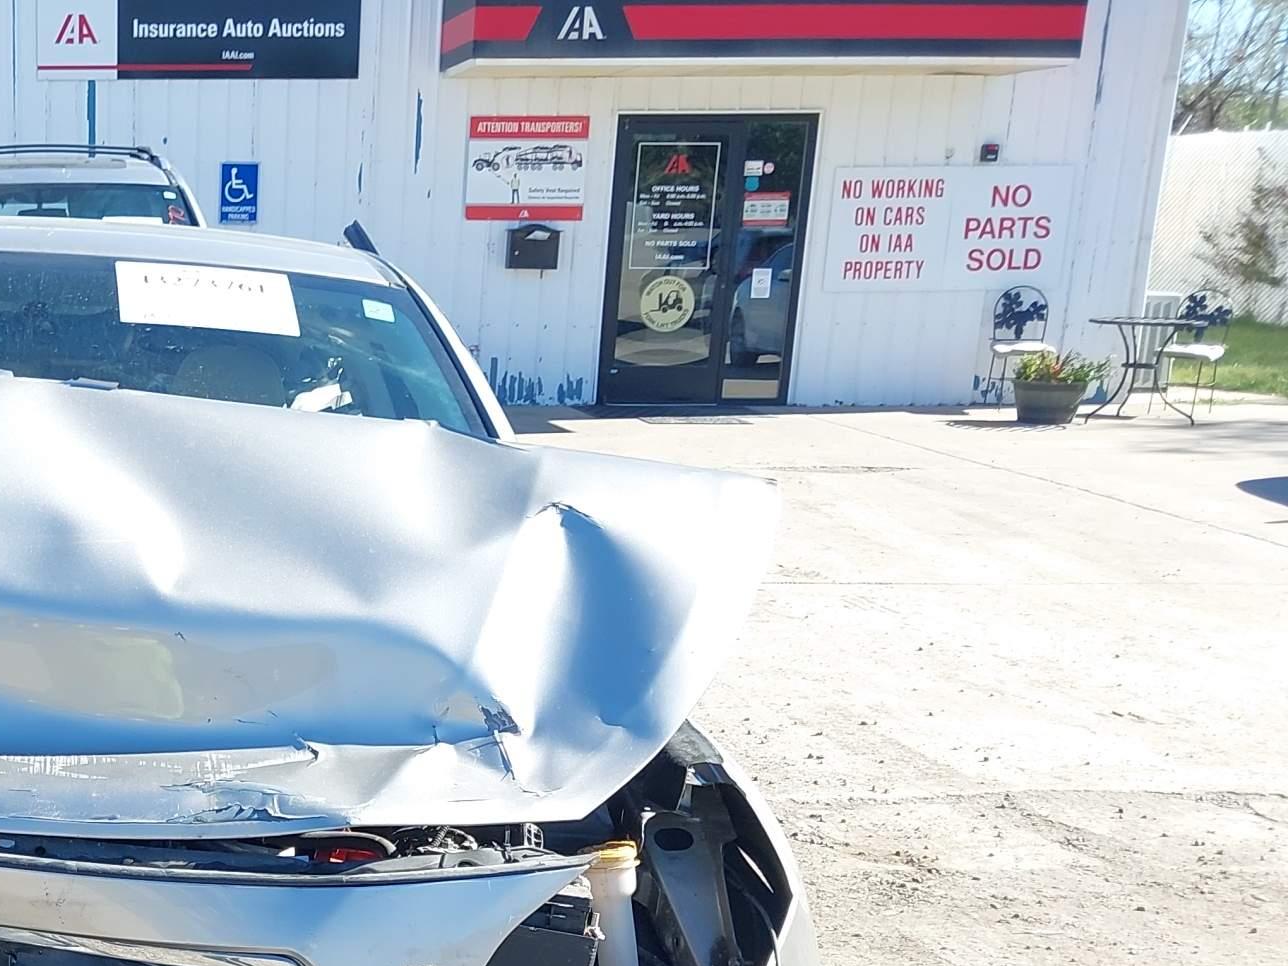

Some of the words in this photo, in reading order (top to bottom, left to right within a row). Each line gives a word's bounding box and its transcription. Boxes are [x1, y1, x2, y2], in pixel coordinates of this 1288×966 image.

[132, 18, 218, 38] Insurance
[223, 18, 263, 38] Auto
[268, 18, 345, 38] Auctions
[477, 121, 519, 133] ATTENTION
[520, 121, 583, 133] TRANSPORTERS!
[841, 179, 862, 199] NO
[871, 178, 945, 199] WORKING
[991, 184, 1032, 208] NO
[855, 207, 876, 226] ON
[883, 206, 925, 226] CARS
[963, 216, 1052, 240] PARTS
[859, 234, 881, 253] ON
[888, 234, 913, 253] IAA
[966, 248, 1042, 271] SOLD
[843, 260, 924, 280] PROPERTY
